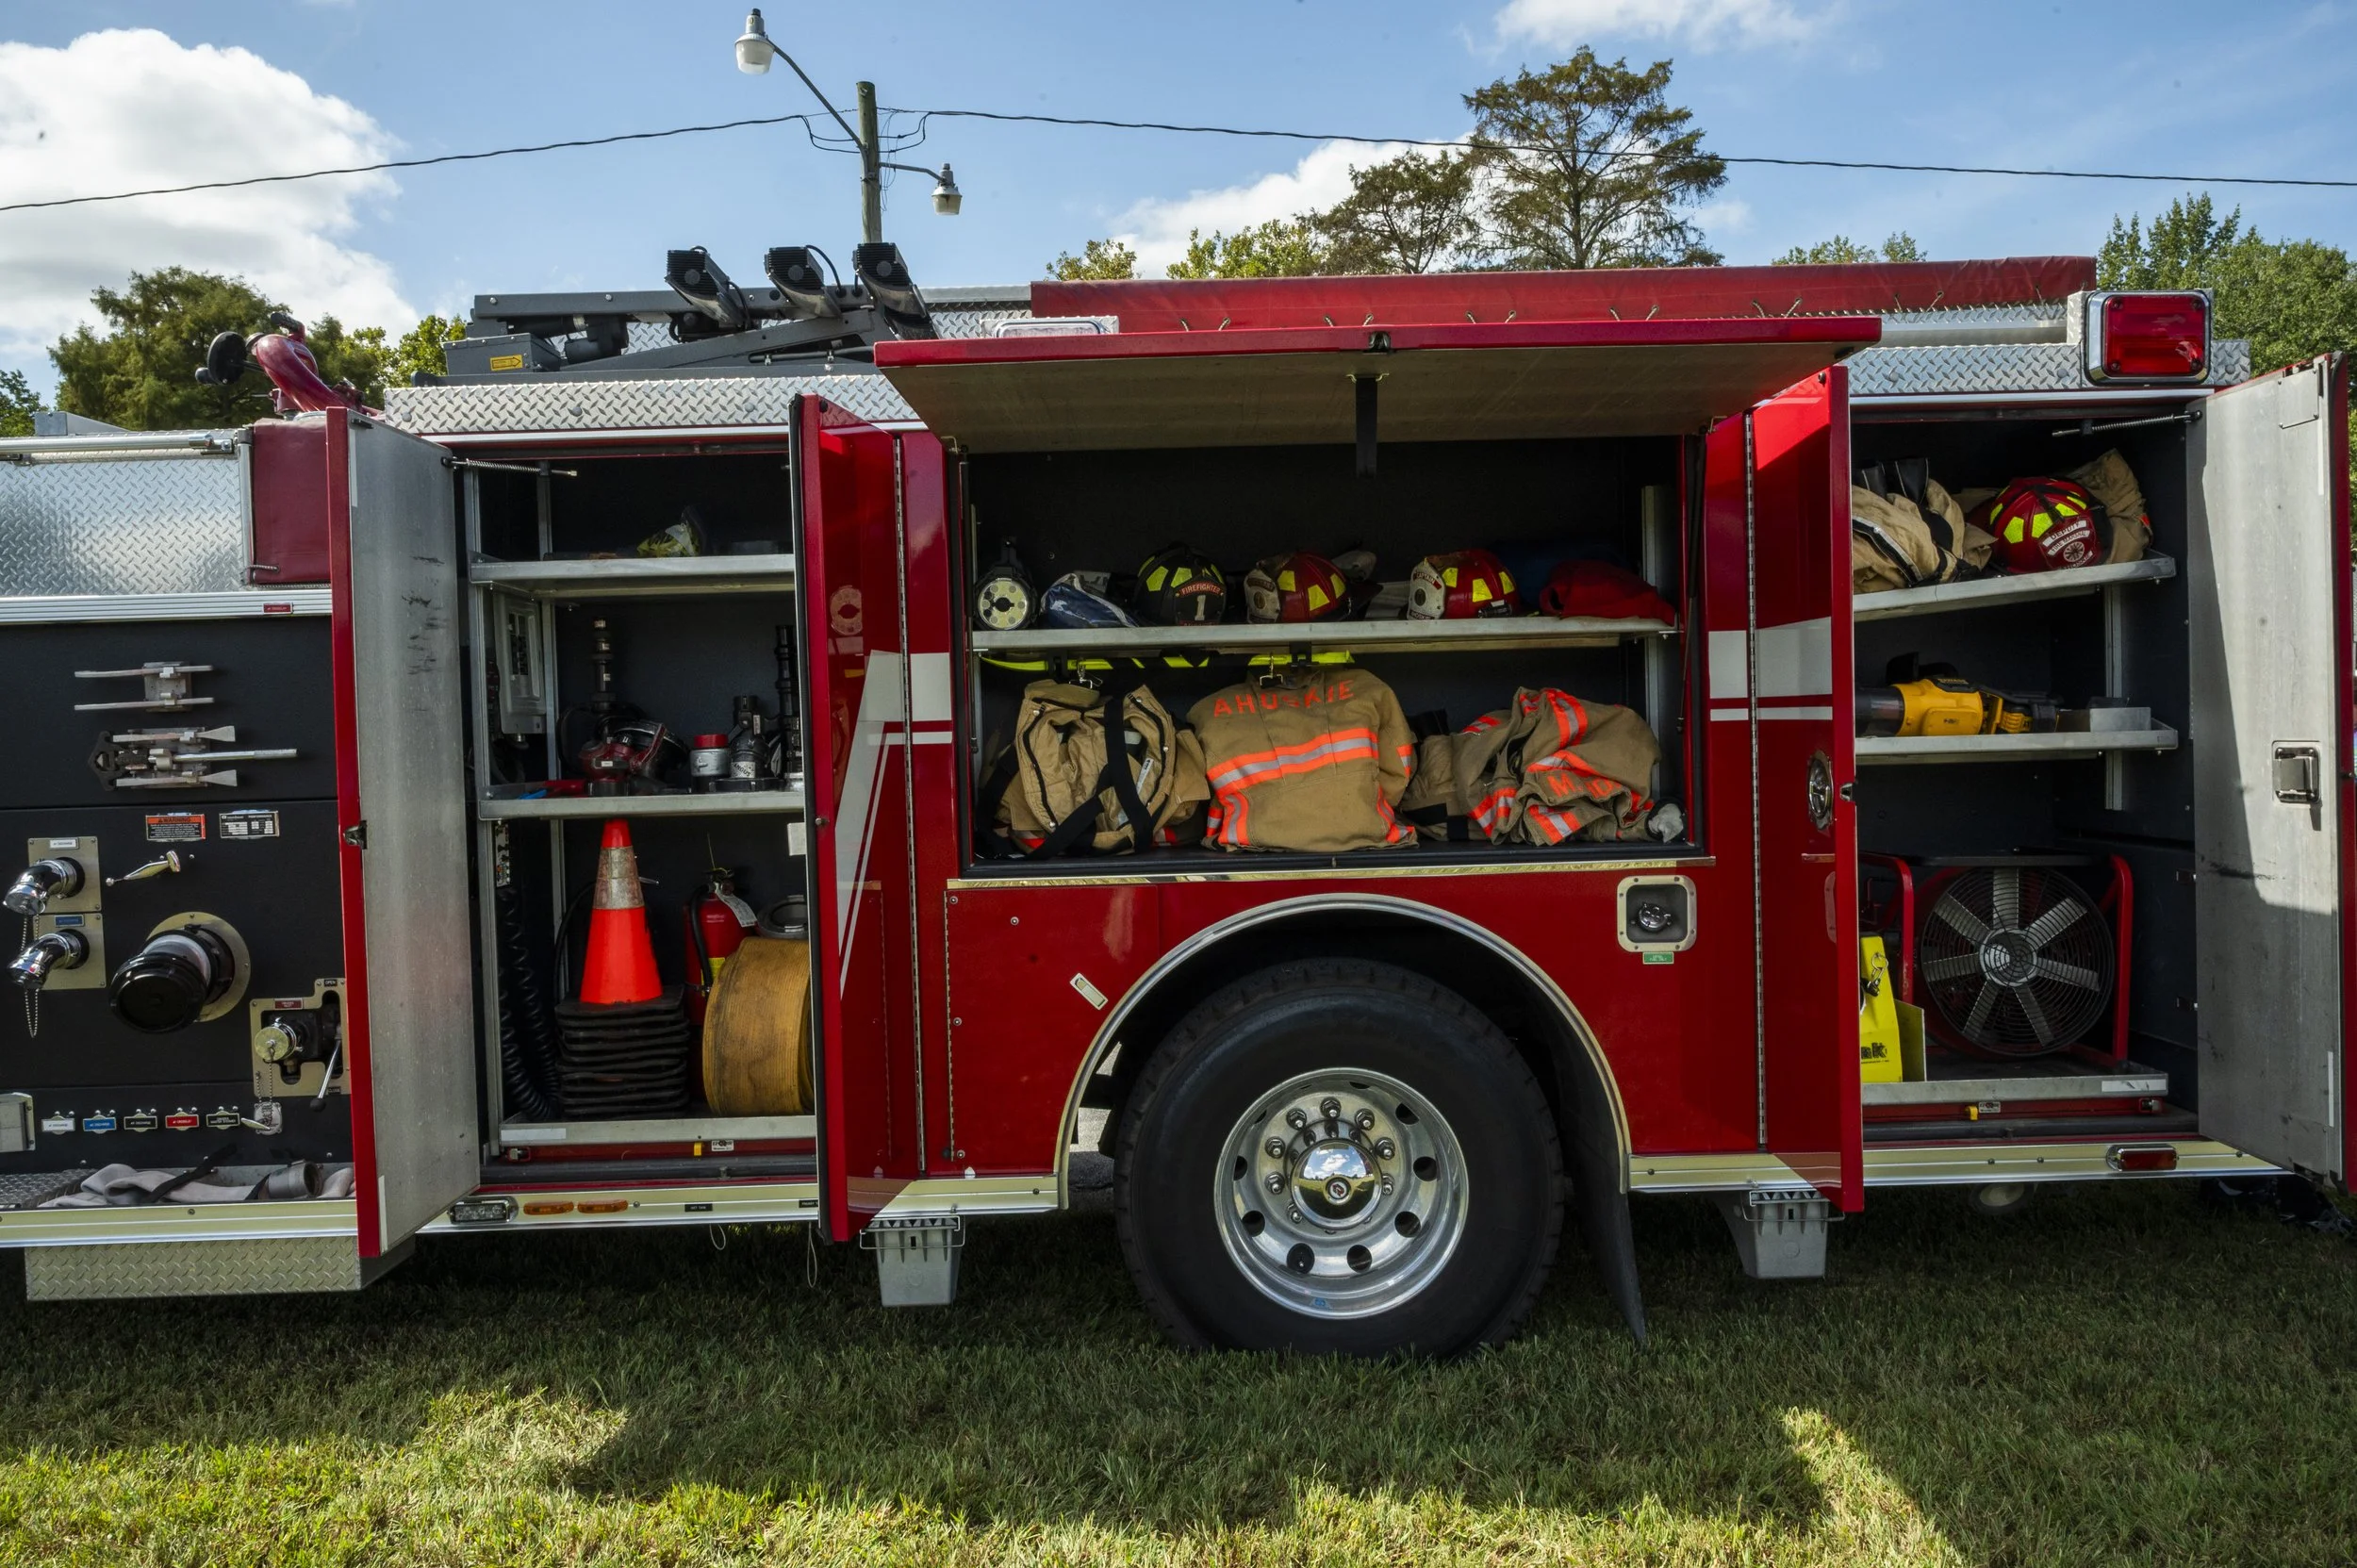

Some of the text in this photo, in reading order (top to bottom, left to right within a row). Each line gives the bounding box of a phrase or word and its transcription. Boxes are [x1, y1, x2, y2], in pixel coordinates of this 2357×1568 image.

[2051, 521, 2080, 540] DEPUTY
[1181, 584, 1221, 594] FIREFIGHTER
[1194, 594, 1206, 621] 1
